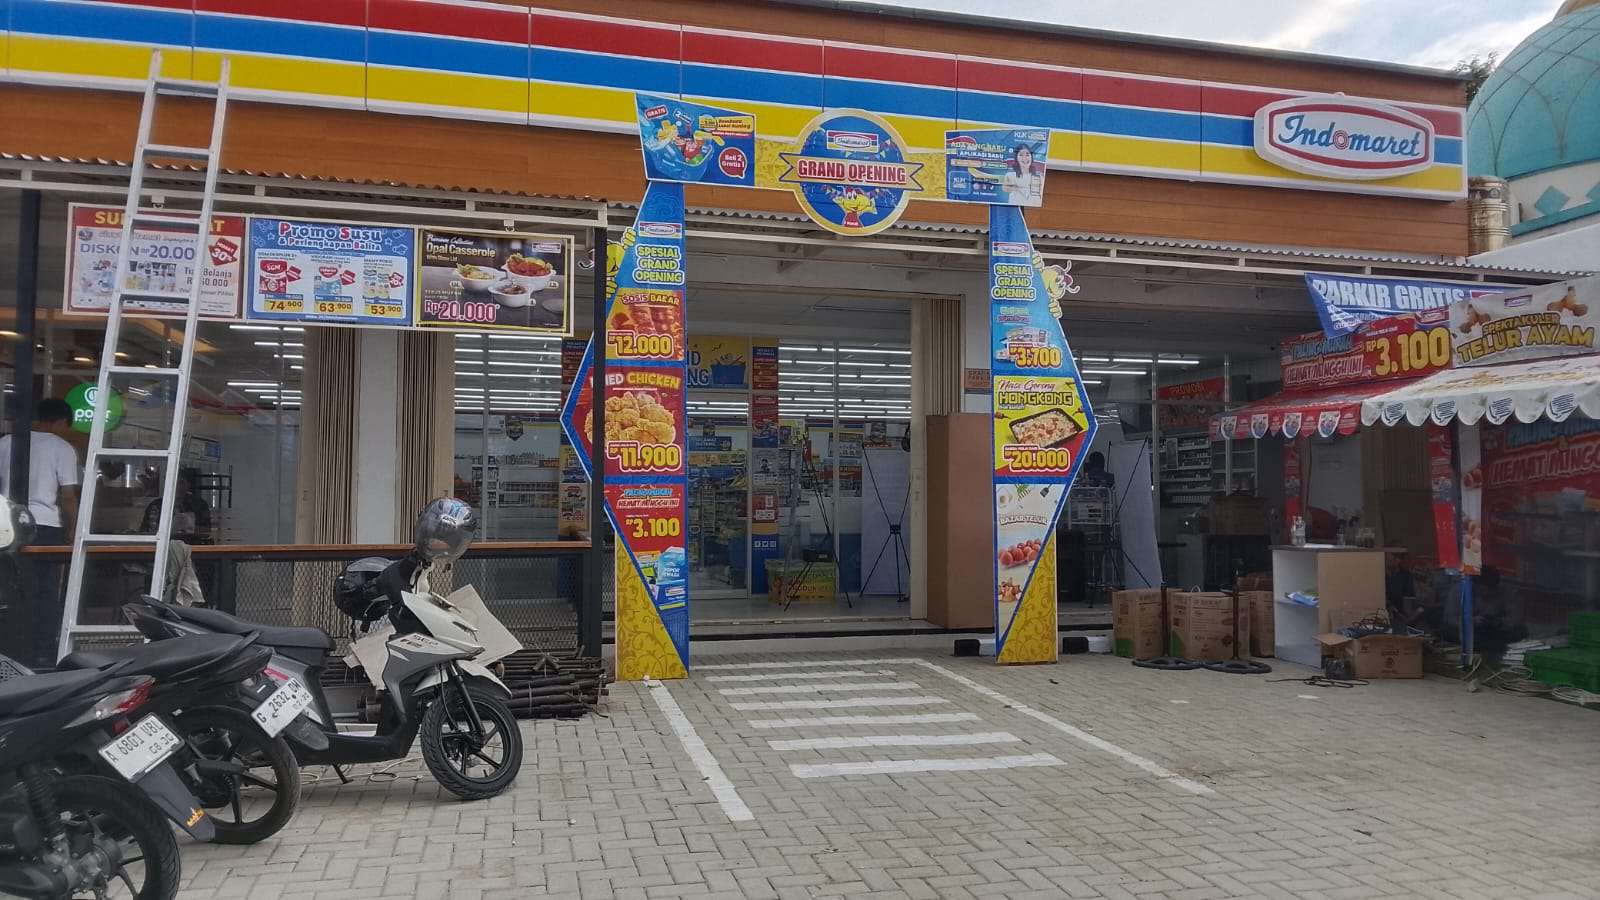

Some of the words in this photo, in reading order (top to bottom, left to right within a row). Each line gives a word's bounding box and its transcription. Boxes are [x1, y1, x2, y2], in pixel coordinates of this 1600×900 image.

[1278, 114, 1422, 160] Indomaret
[798, 160, 845, 179] GRAND
[848, 164, 907, 184] OPENING
[279, 222, 337, 239] Promo
[340, 227, 382, 240] Susu
[80, 243, 141, 256] DISKN
[278, 238, 287, 246] &
[288, 238, 352, 249] Perlengkapan
[353, 242, 381, 251] Balita
[426, 242, 448, 255] Opal
[449, 244, 496, 258] Casserole
[637, 246, 680, 258] SPESIAL
[638, 260, 678, 270] GRAND
[995, 265, 1032, 275] SPESIAL
[203, 269, 232, 280] Belanja
[634, 271, 682, 282] OPENING
[997, 277, 1030, 286] GRAND
[622, 295, 649, 305] SOSIS
[649, 294, 680, 305] BAKAR
[993, 289, 1035, 298] OPENING
[1312, 280, 1391, 308] PARKIR
[1393, 285, 1465, 310] GRATIS
[1482, 312, 1561, 335] SPEKTAKULER
[1457, 329, 1523, 363] TELUR
[1526, 324, 1595, 348] AYAM
[626, 371, 681, 389] CHICKEN
[1023, 380, 1056, 391] Goreng
[999, 391, 1073, 406] HONGKONG
[256, 712, 267, 723] G
[268, 691, 291, 712] 2632
[105, 750, 119, 762] A
[116, 732, 145, 755] 6801
